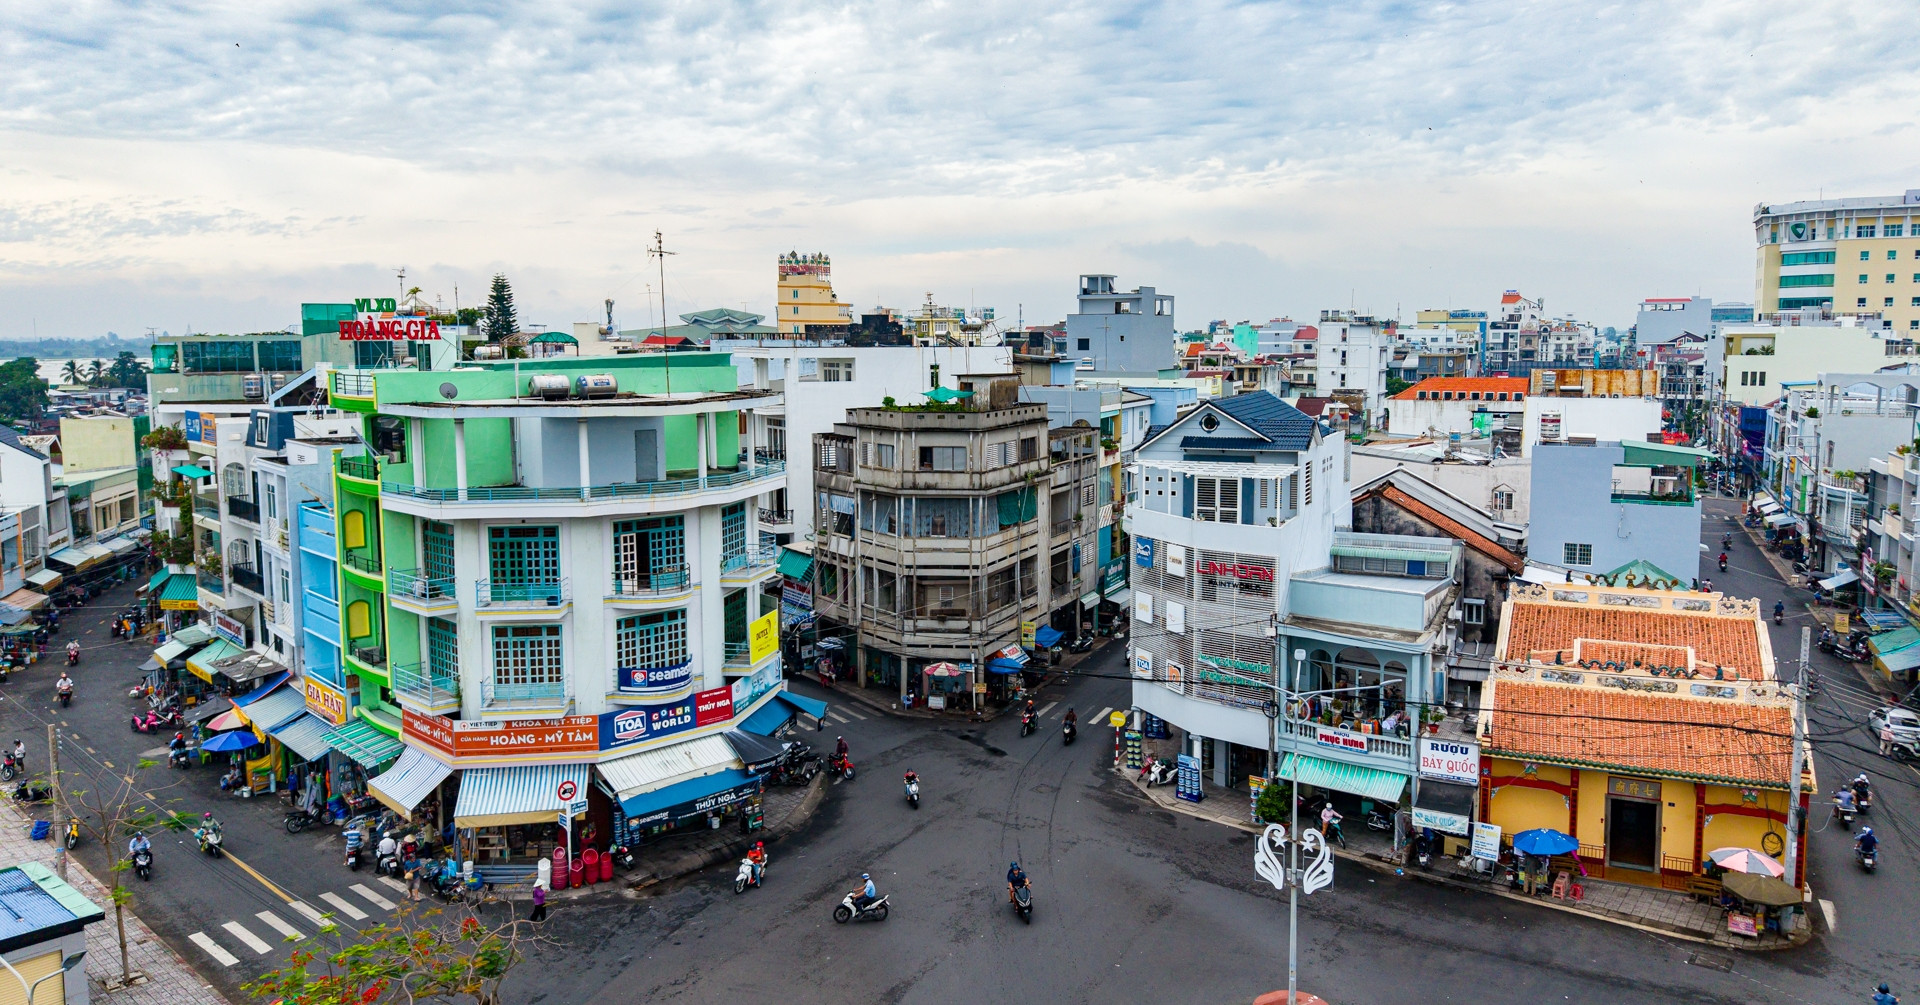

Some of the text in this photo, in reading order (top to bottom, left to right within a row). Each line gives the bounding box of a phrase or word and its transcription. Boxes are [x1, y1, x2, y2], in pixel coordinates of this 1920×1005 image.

[355, 298, 396, 312] VLXD
[339, 315, 441, 340] HOÀNG GIA
[717, 699, 730, 708] NGA
[652, 706, 690, 720] COLOR
[617, 718, 643, 732] TOA
[652, 715, 691, 731] WORLD
[490, 732, 535, 746] HOÀNG
[545, 730, 564, 743] MỸ
[567, 729, 593, 742] TÂM
[1430, 742, 1469, 756] RƯỢU
[1422, 753, 1476, 774] BẢY QUỐC
[717, 792, 736, 804] NGA
